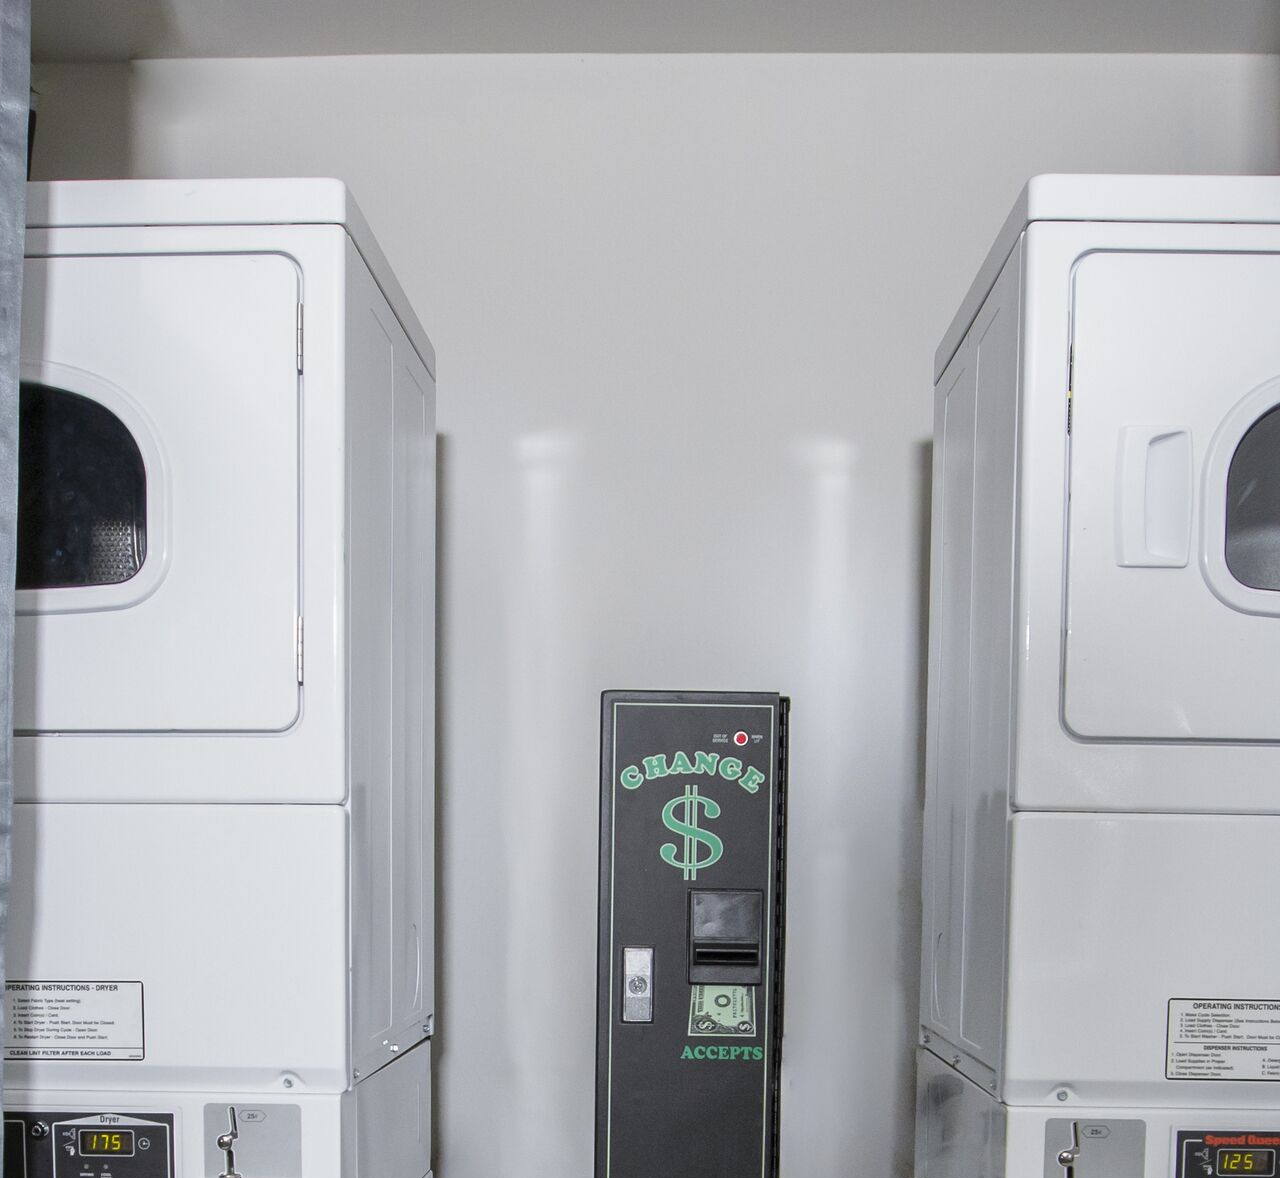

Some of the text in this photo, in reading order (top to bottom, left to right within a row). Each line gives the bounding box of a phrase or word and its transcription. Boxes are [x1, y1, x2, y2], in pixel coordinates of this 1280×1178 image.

[621, 751, 765, 793] CHANGE
[660, 785, 723, 880] $
[680, 1045, 763, 1060] ACCEPTS
[100, 1116, 120, 1124] Dryer
[93, 1134, 121, 1150] 175
[1205, 1135, 1245, 1146] Speed
[1223, 1154, 1253, 1170] 125
